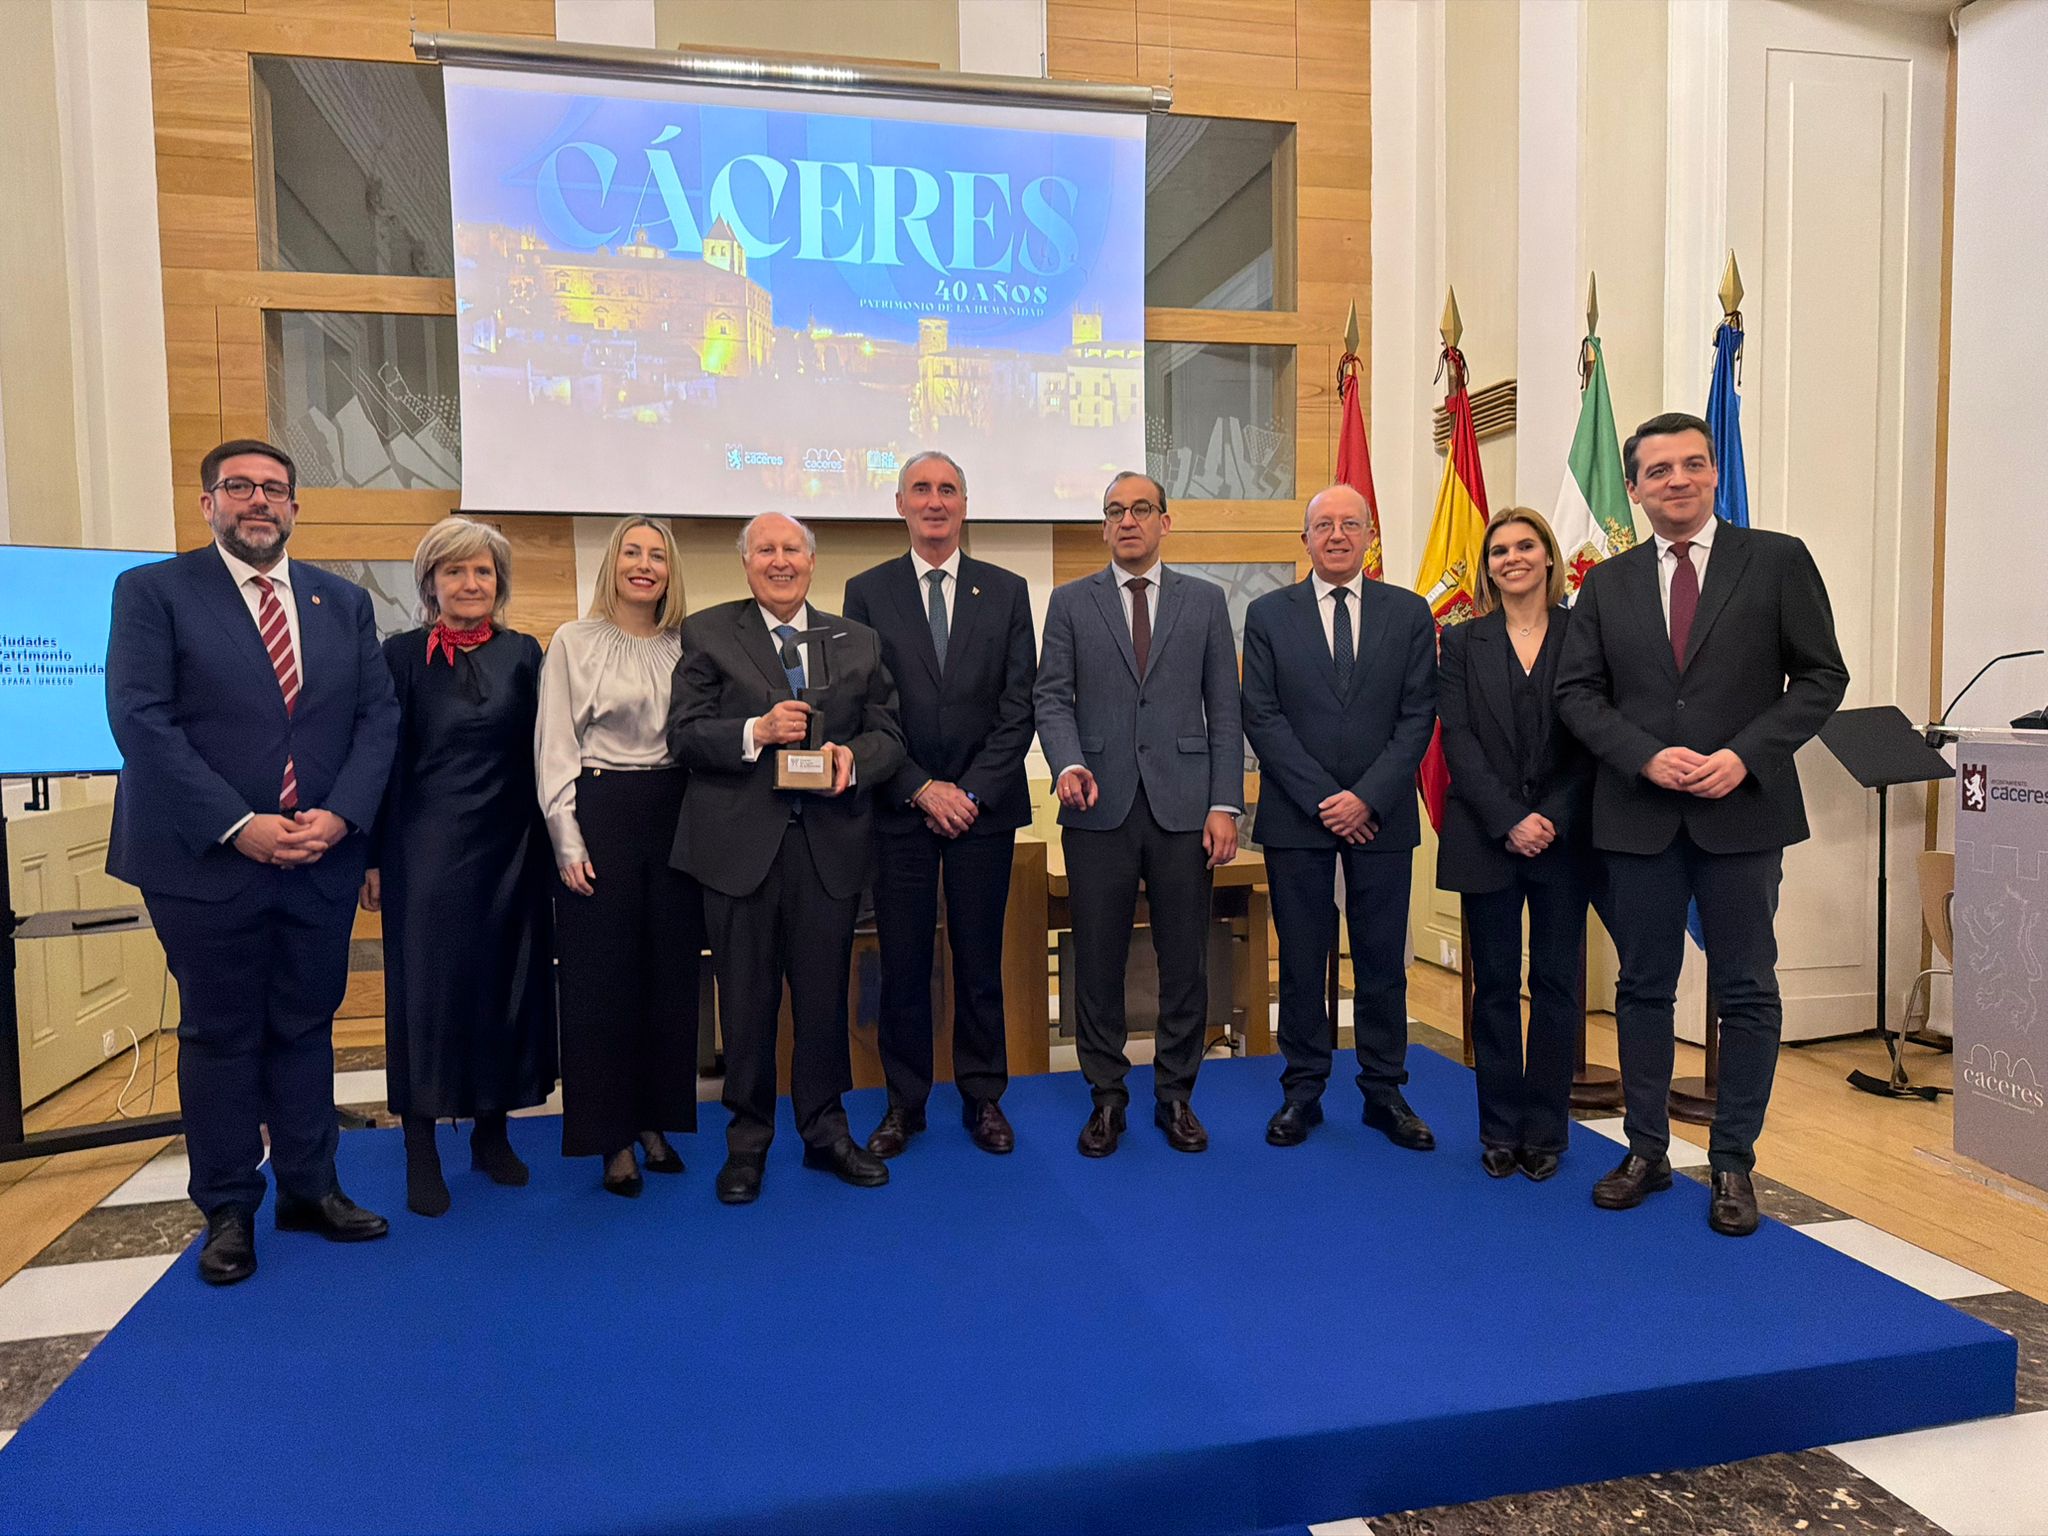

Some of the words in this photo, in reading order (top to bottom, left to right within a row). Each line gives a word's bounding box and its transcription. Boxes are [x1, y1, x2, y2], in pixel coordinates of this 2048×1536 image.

[536, 125, 1080, 277] CÁCERES
[934, 279, 968, 301] 40
[973, 280, 1048, 305] AÑOS
[859, 298, 934, 312] PATRIMONIO
[938, 303, 953, 313] DE
[956, 304, 971, 314] LA
[974, 304, 1044, 317] HUMANIDAD
[0, 635, 57, 647] iudades
[18, 662, 30, 674] la
[36, 662, 104, 674] Humanida
[0, 677, 31, 685] SPAÑA
[39, 677, 73, 685] UNESCO
